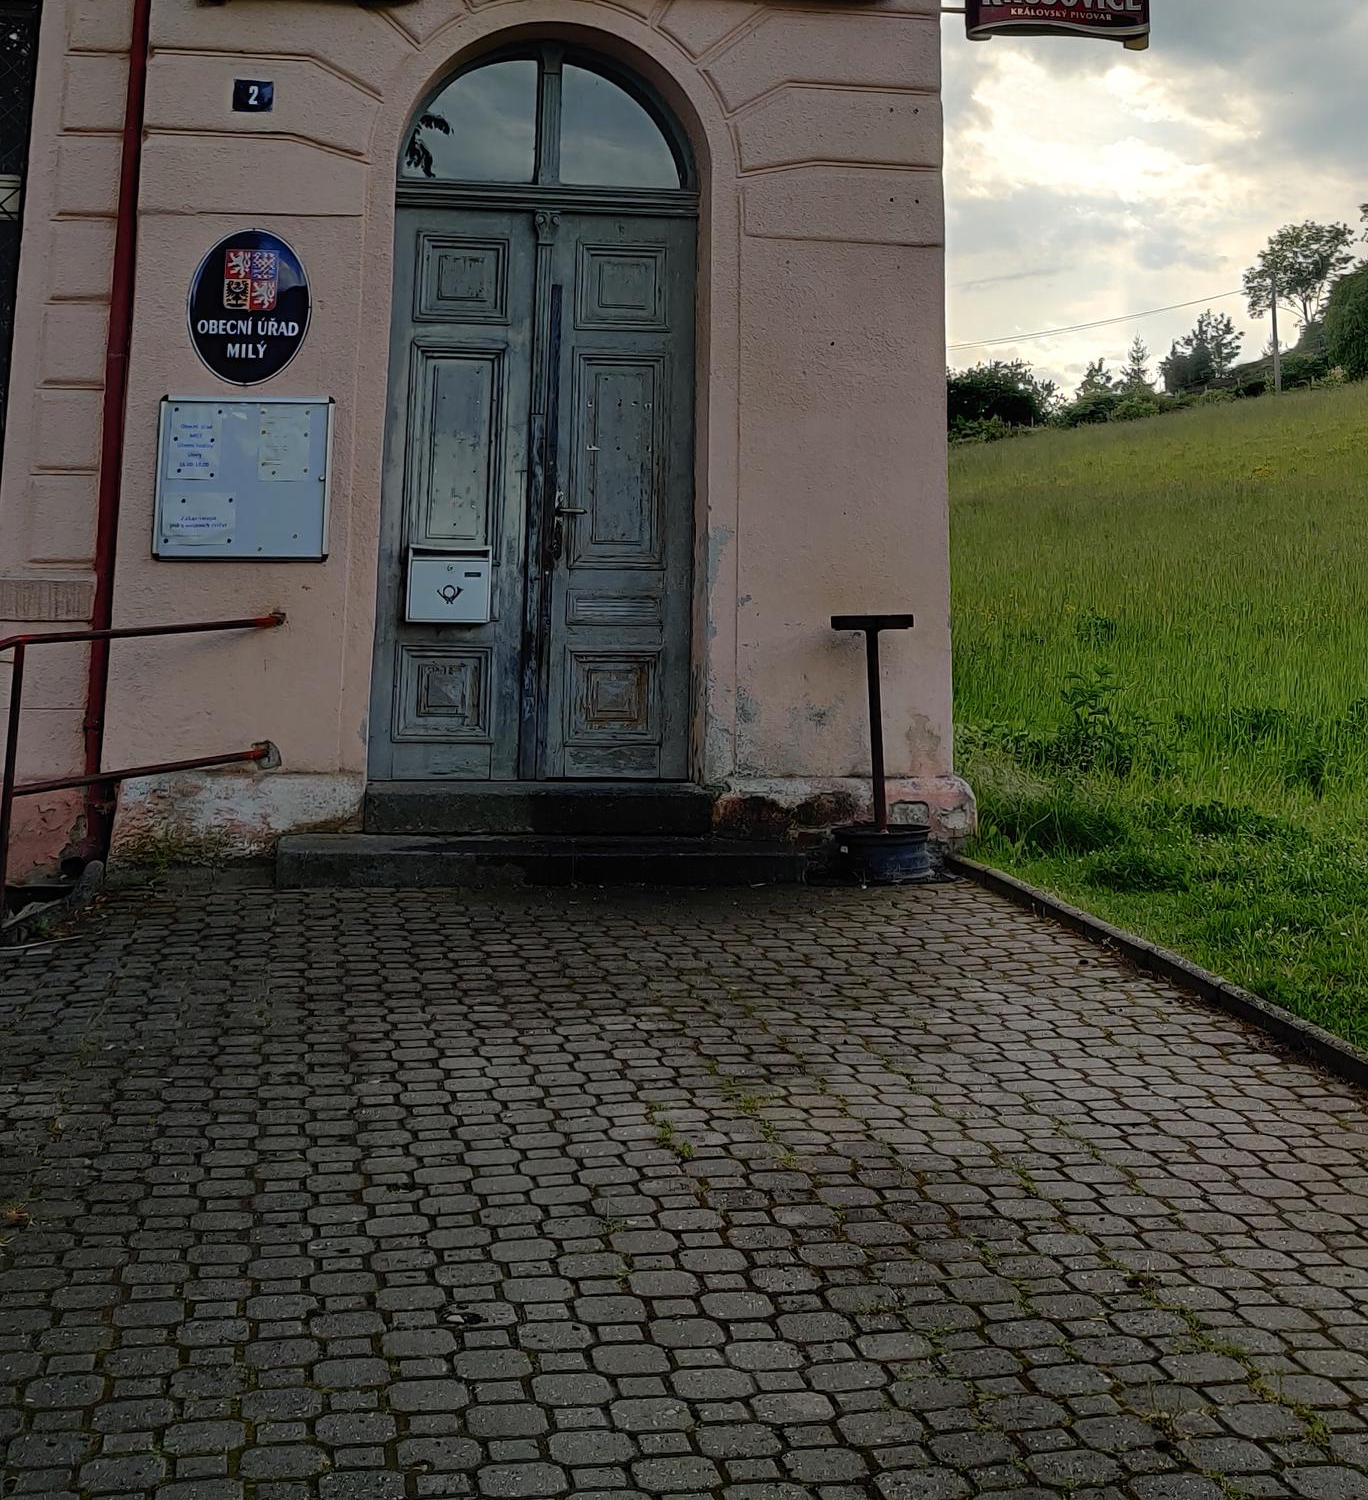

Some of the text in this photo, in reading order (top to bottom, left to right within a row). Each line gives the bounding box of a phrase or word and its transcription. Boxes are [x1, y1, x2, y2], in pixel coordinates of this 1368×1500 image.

[1010, 6, 1112, 21] KRÁLOVSKÝ PIVOVAR
[248, 85, 259, 105] 2
[197, 317, 299, 337] OBECNÍ ÚŘAD
[226, 341, 267, 359] MILÝ
